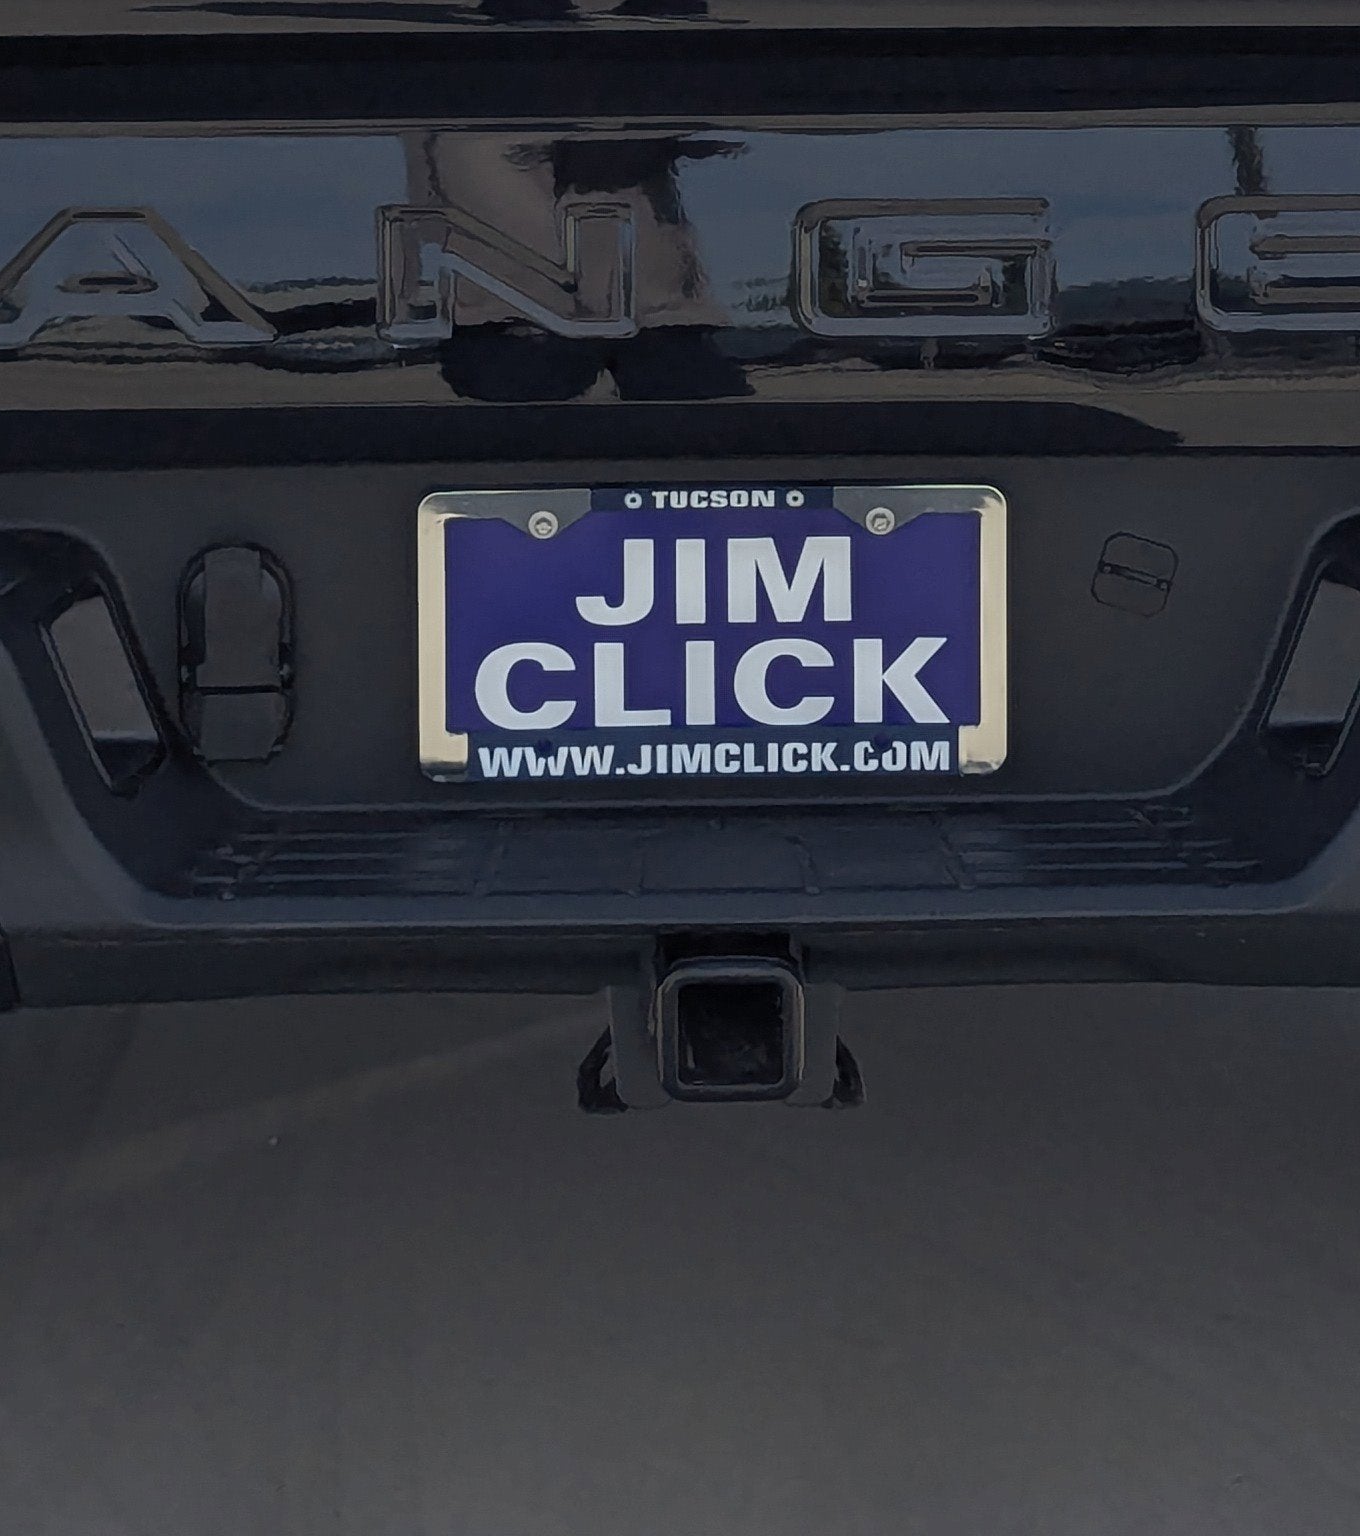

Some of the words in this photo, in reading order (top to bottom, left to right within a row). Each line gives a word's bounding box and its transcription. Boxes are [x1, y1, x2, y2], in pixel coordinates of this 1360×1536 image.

[651, 489, 777, 510] TUCSON
[574, 535, 853, 627] JIM
[473, 636, 951, 731] CLICK
[477, 739, 952, 780] WWW.JIMCLICK.COM
